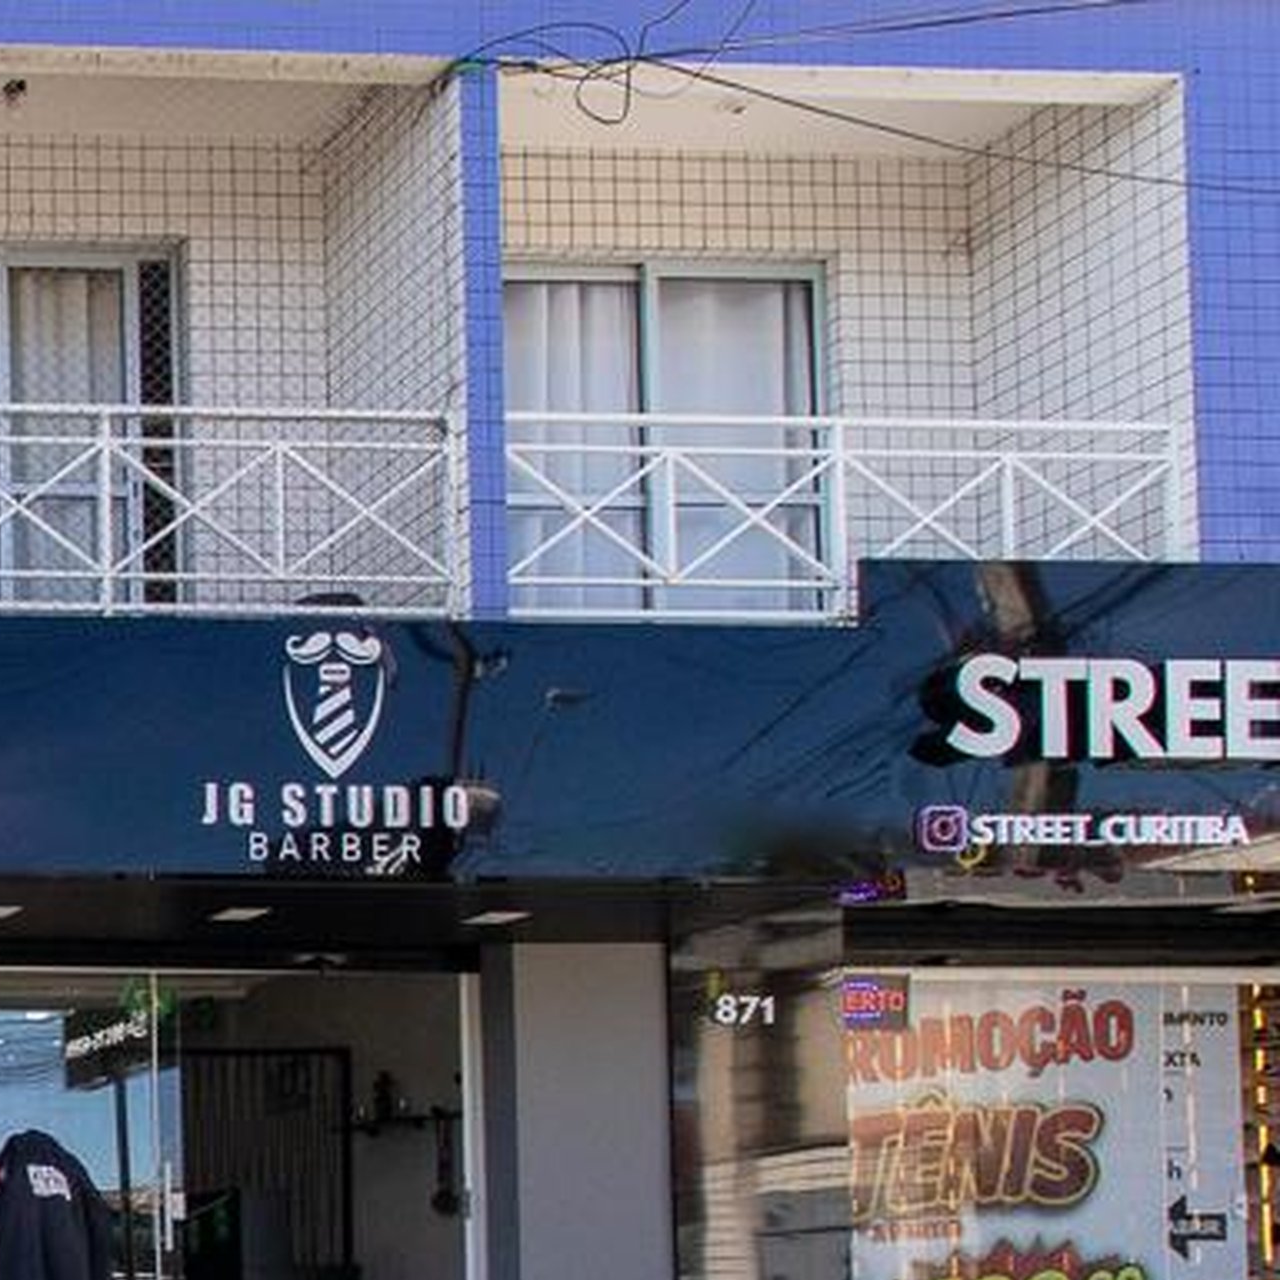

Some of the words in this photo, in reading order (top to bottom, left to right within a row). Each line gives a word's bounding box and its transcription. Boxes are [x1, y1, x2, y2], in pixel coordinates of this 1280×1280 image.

[945, 653, 1280, 758] STREE
[201, 783, 254, 824] JG
[281, 783, 470, 828] STUDIO
[971, 815, 1249, 845] STREET_CURITIBA
[248, 832, 421, 862] BARBER
[716, 994, 774, 1024] 871
